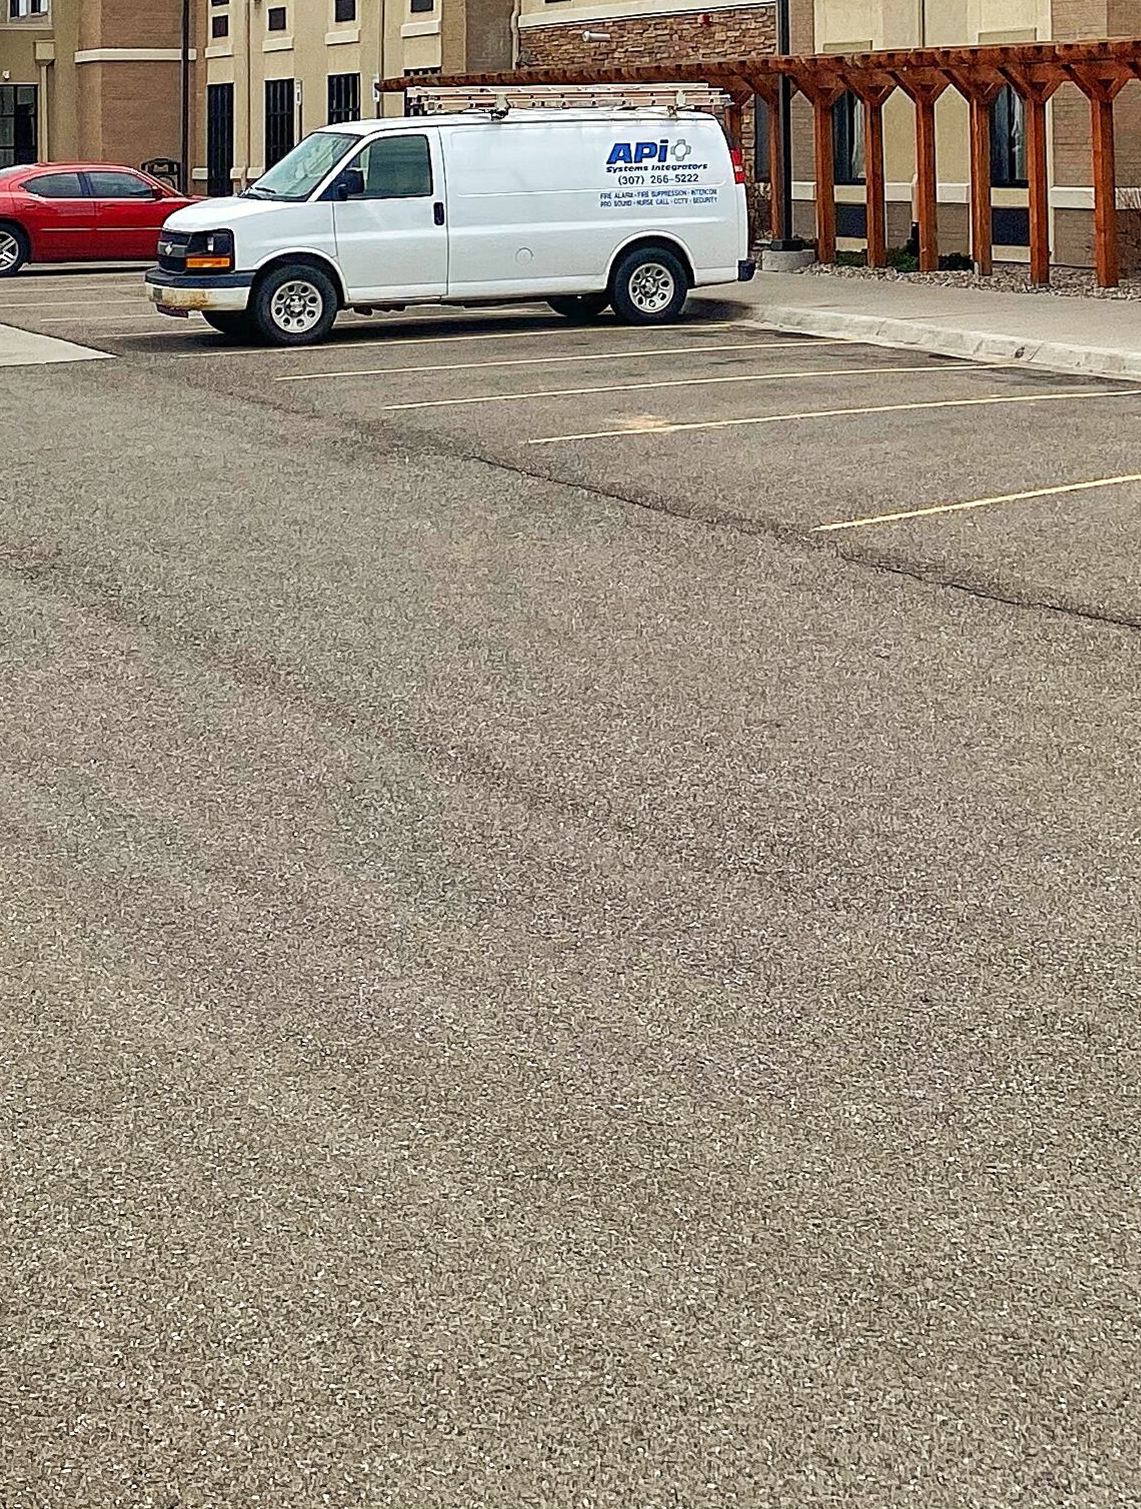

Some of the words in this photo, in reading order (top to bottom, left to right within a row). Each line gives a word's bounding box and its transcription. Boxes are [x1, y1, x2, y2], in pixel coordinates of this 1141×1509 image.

[605, 165, 648, 173] Systems
[651, 163, 708, 171] Integrators
[618, 175, 645, 185] (307)
[650, 173, 699, 184] 266-5222
